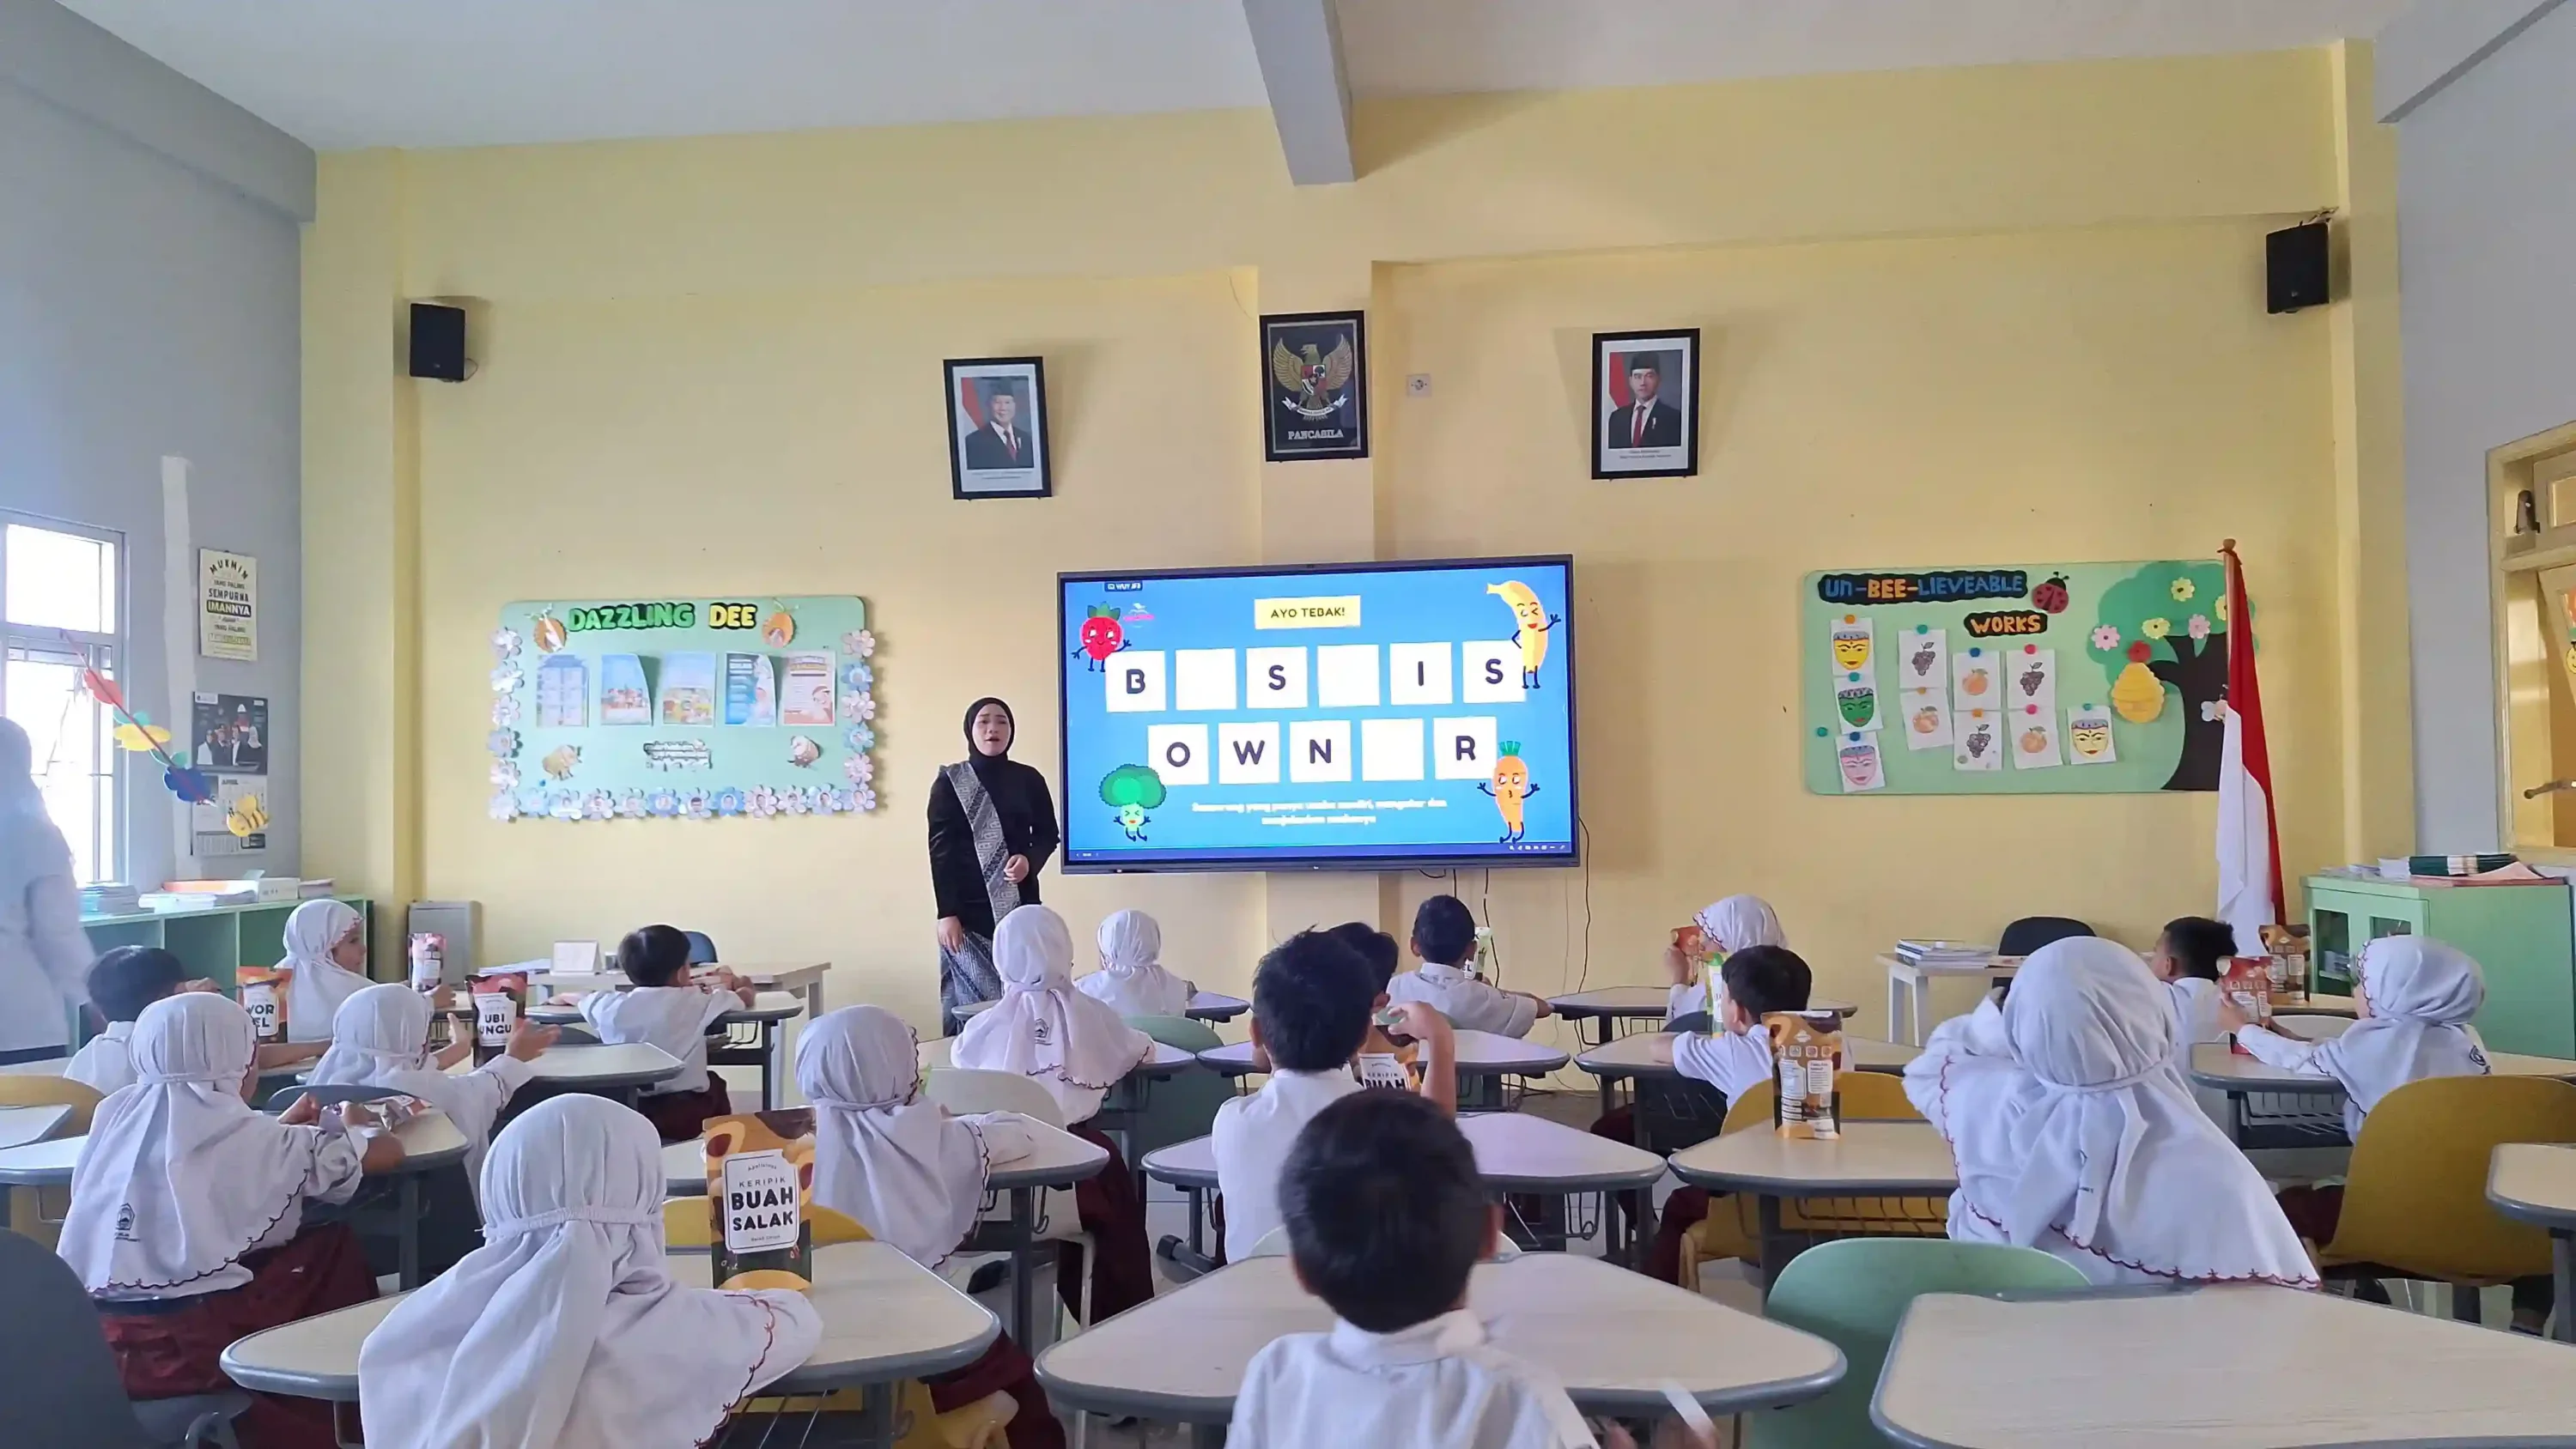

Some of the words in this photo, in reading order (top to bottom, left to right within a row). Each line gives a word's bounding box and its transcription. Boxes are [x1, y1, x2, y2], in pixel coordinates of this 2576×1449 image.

[1288, 429, 1344, 440] PANCASILA
[210, 559, 248, 579] MUKMIN
[209, 587, 249, 602] SEMPURNA
[208, 601, 250, 616] IMANNYA
[568, 603, 695, 631] DAZZLING
[708, 603, 757, 629] DEE
[1270, 608, 1297, 618] AYO
[1301, 607, 1346, 617] TEBAK!
[1970, 615, 2041, 634] WORKS
[1126, 668, 1146, 694] B
[1268, 664, 1286, 691] S
[1418, 661, 1425, 687] I
[1485, 658, 1504, 685] S
[1166, 742, 1191, 767] O
[1232, 740, 1266, 766] W
[1309, 738, 1332, 764] N
[1455, 735, 1476, 761] R
[484, 1014, 505, 1023] UBI
[479, 1025, 512, 1034] UNGU
[738, 1176, 787, 1188] KERIPIK
[731, 1186, 793, 1211] BUAH
[732, 1210, 793, 1232] SALAK
